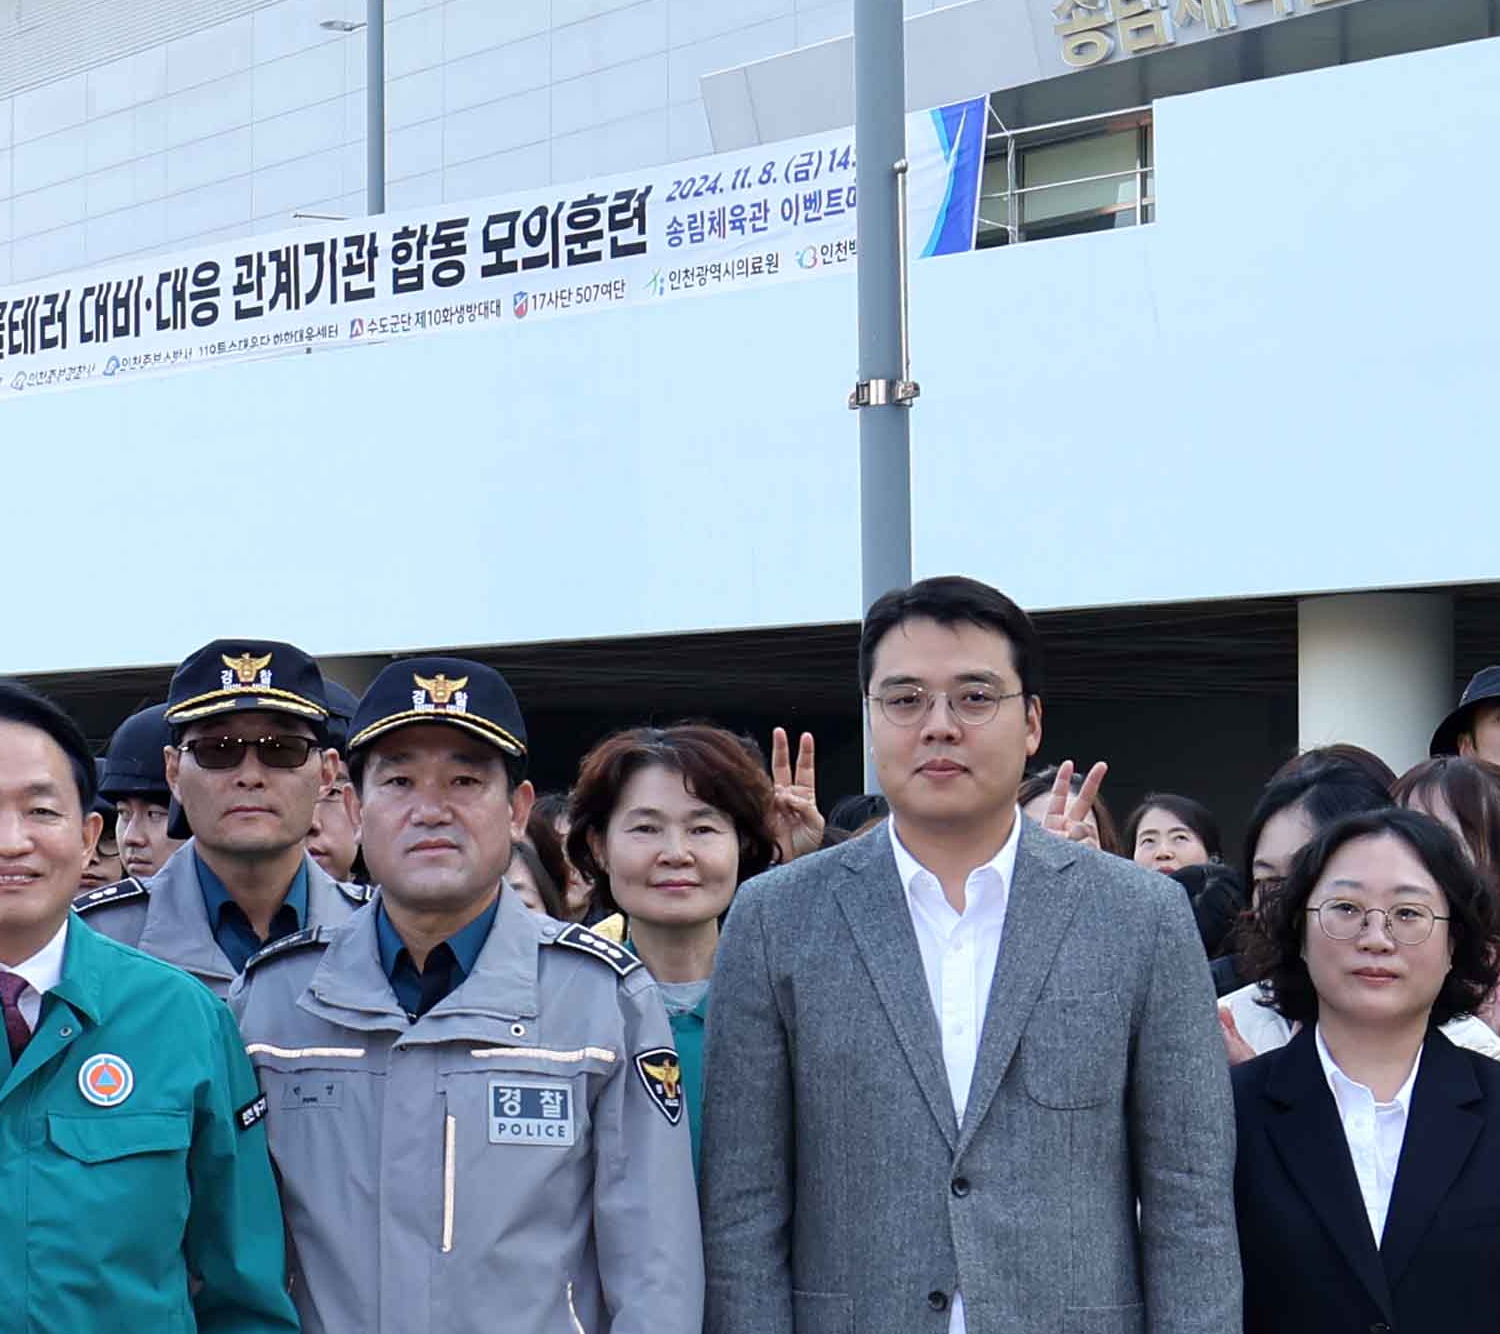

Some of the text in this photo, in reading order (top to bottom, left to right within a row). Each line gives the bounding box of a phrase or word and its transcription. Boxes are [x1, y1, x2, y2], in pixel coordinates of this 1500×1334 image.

[665, 172, 724, 203] 2024.
[785, 150, 822, 183] (금)
[665, 199, 770, 248] 송림체육관
[79, 261, 221, 344] 대비·대응
[232, 232, 378, 321] 관계기관
[392, 217, 471, 295] 합동
[481, 185, 653, 279] 모의훈련
[669, 252, 780, 291] 인천광역시의료원
[532, 279, 626, 311] 17사단 507여단
[367, 299, 501, 334] 수도군단 제10화생방대대
[499, 1088, 564, 1118] 경찰
[498, 1123, 566, 1138] POLICE
